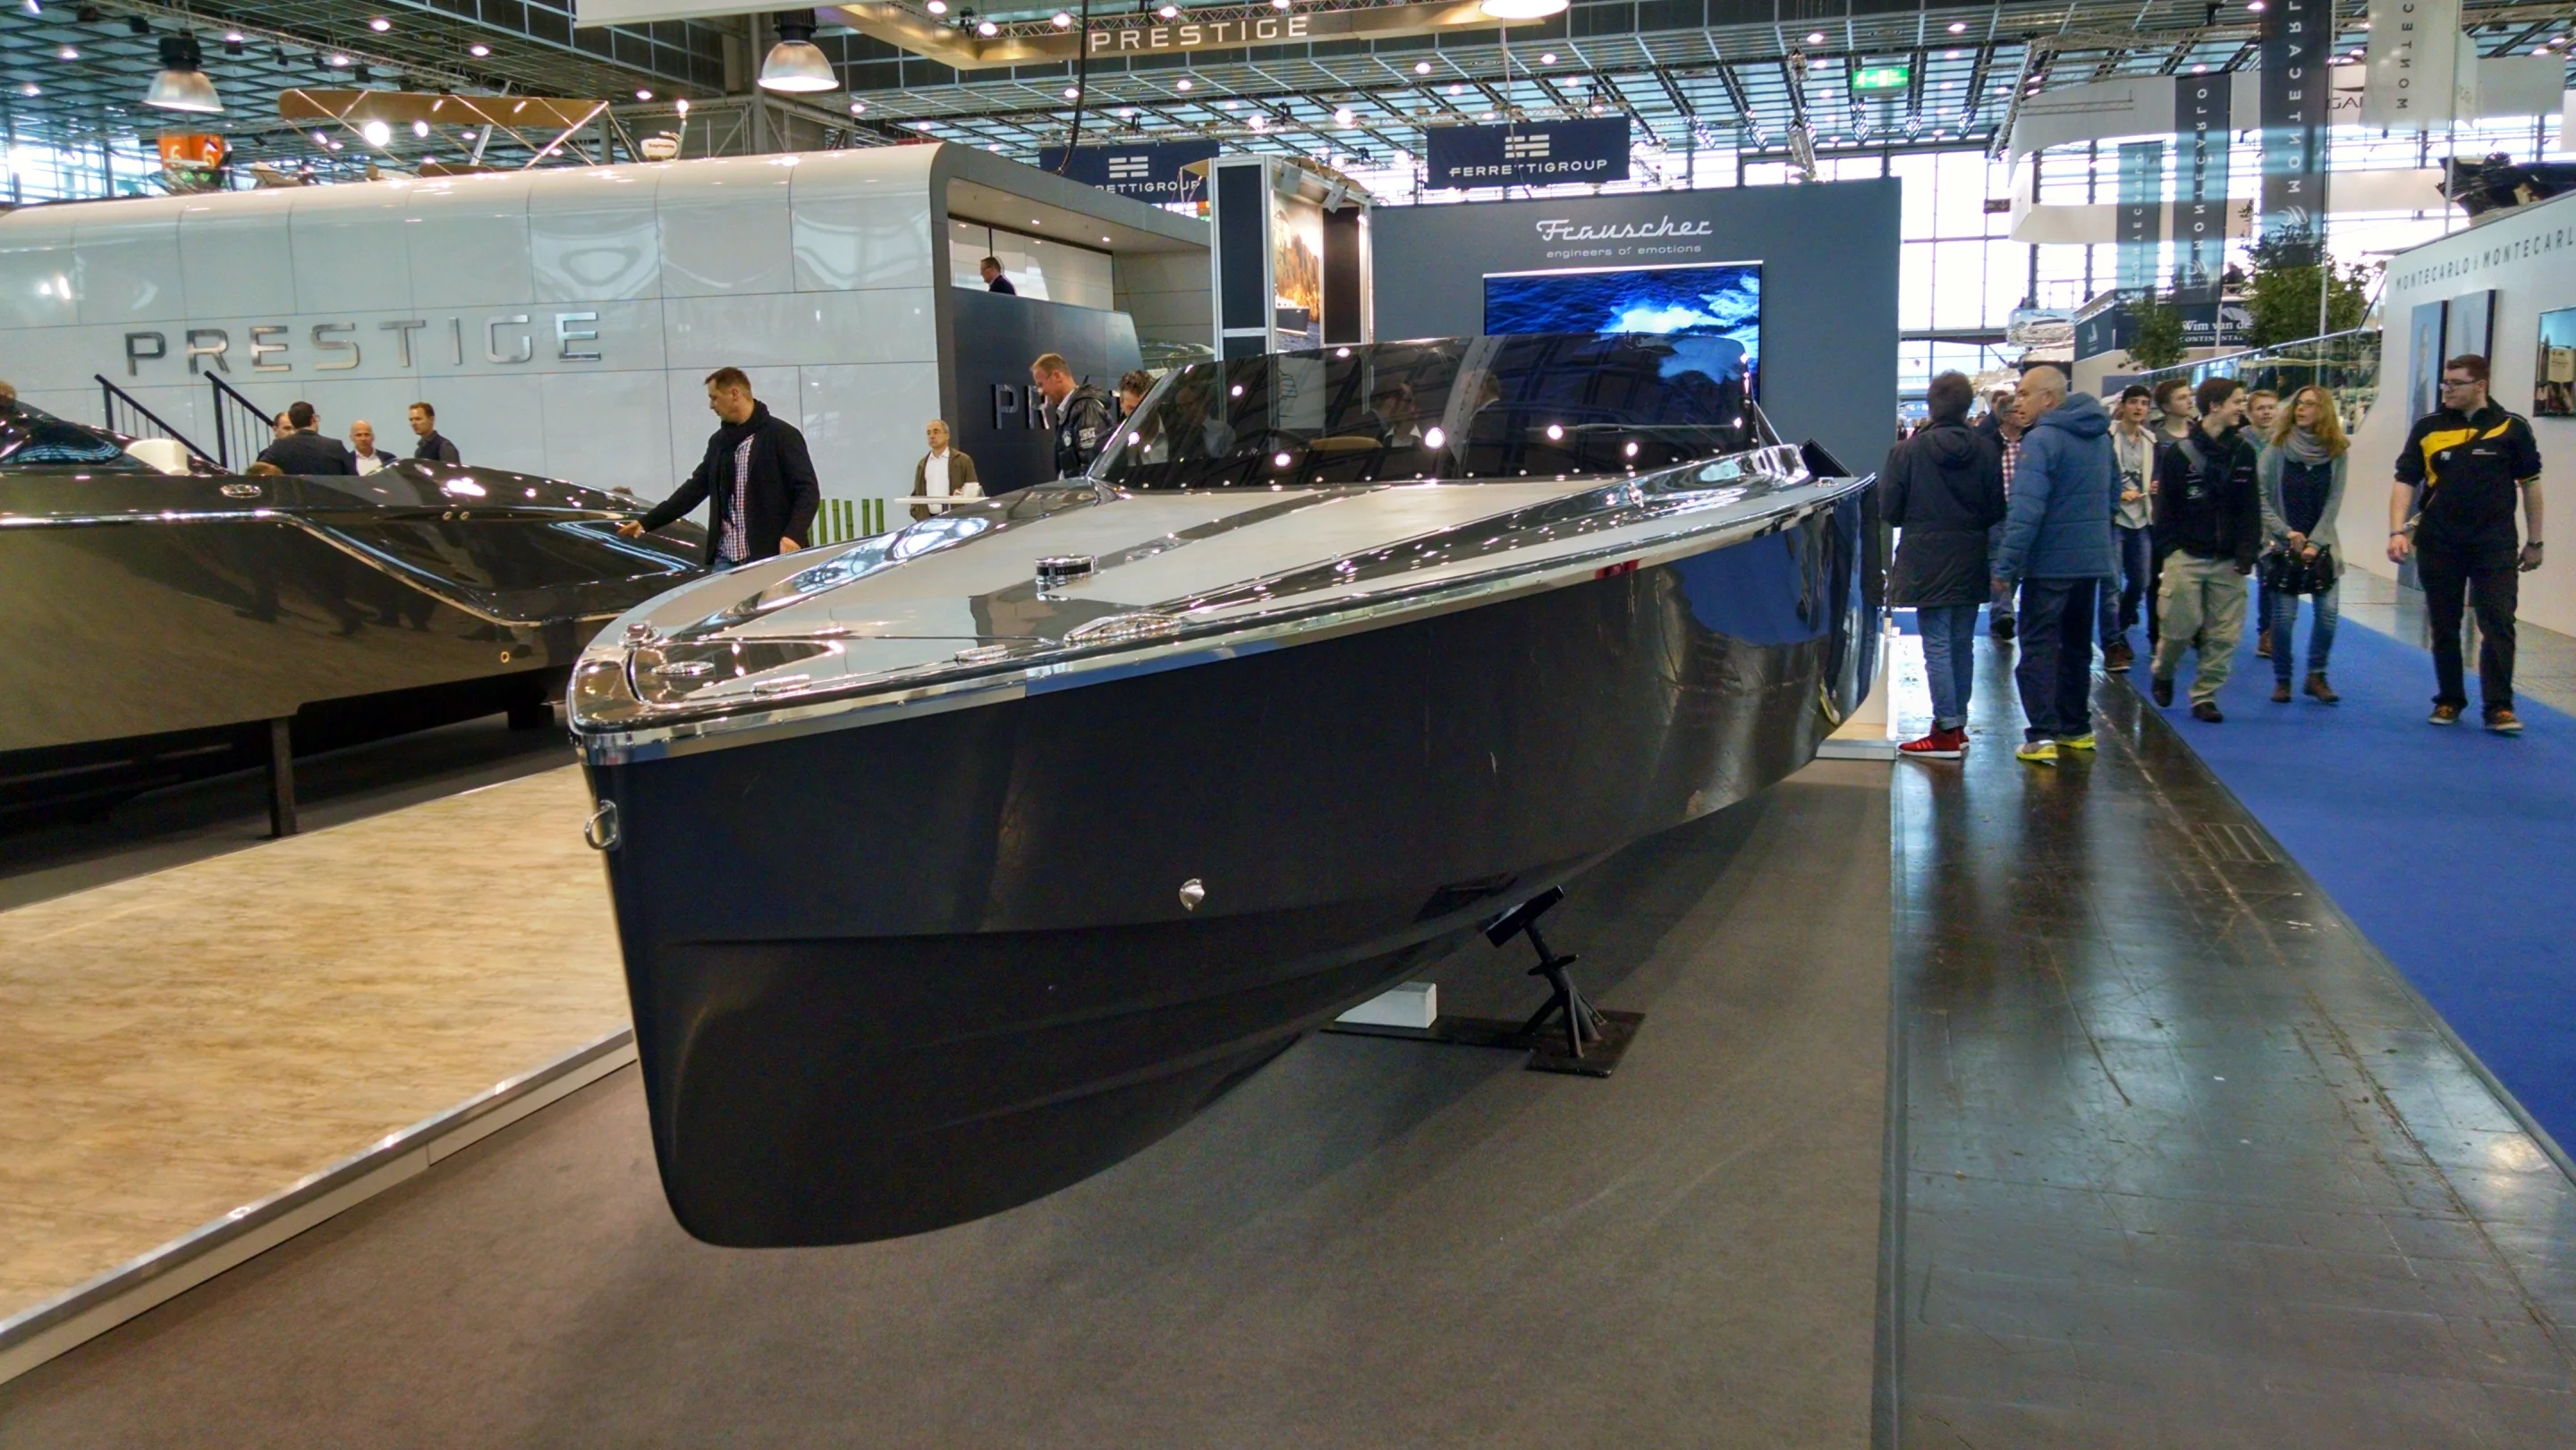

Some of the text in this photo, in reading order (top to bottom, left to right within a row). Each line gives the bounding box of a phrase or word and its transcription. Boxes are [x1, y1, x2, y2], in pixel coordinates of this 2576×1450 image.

[1090, 16, 1308, 52] PRESTIGE
[2326, 96, 2363, 110] GA
[1536, 215, 1713, 241] Frauscher
[1546, 244, 1702, 259] engineers of emotions
[2483, 226, 2574, 268] MONTECARL
[2396, 257, 2469, 292] MONTECARLO
[2182, 319, 2208, 331] Wim
[2212, 322, 2233, 330] van
[124, 312, 601, 377] PRESTIGE
[2179, 335, 2243, 343] CONTINNTAL
